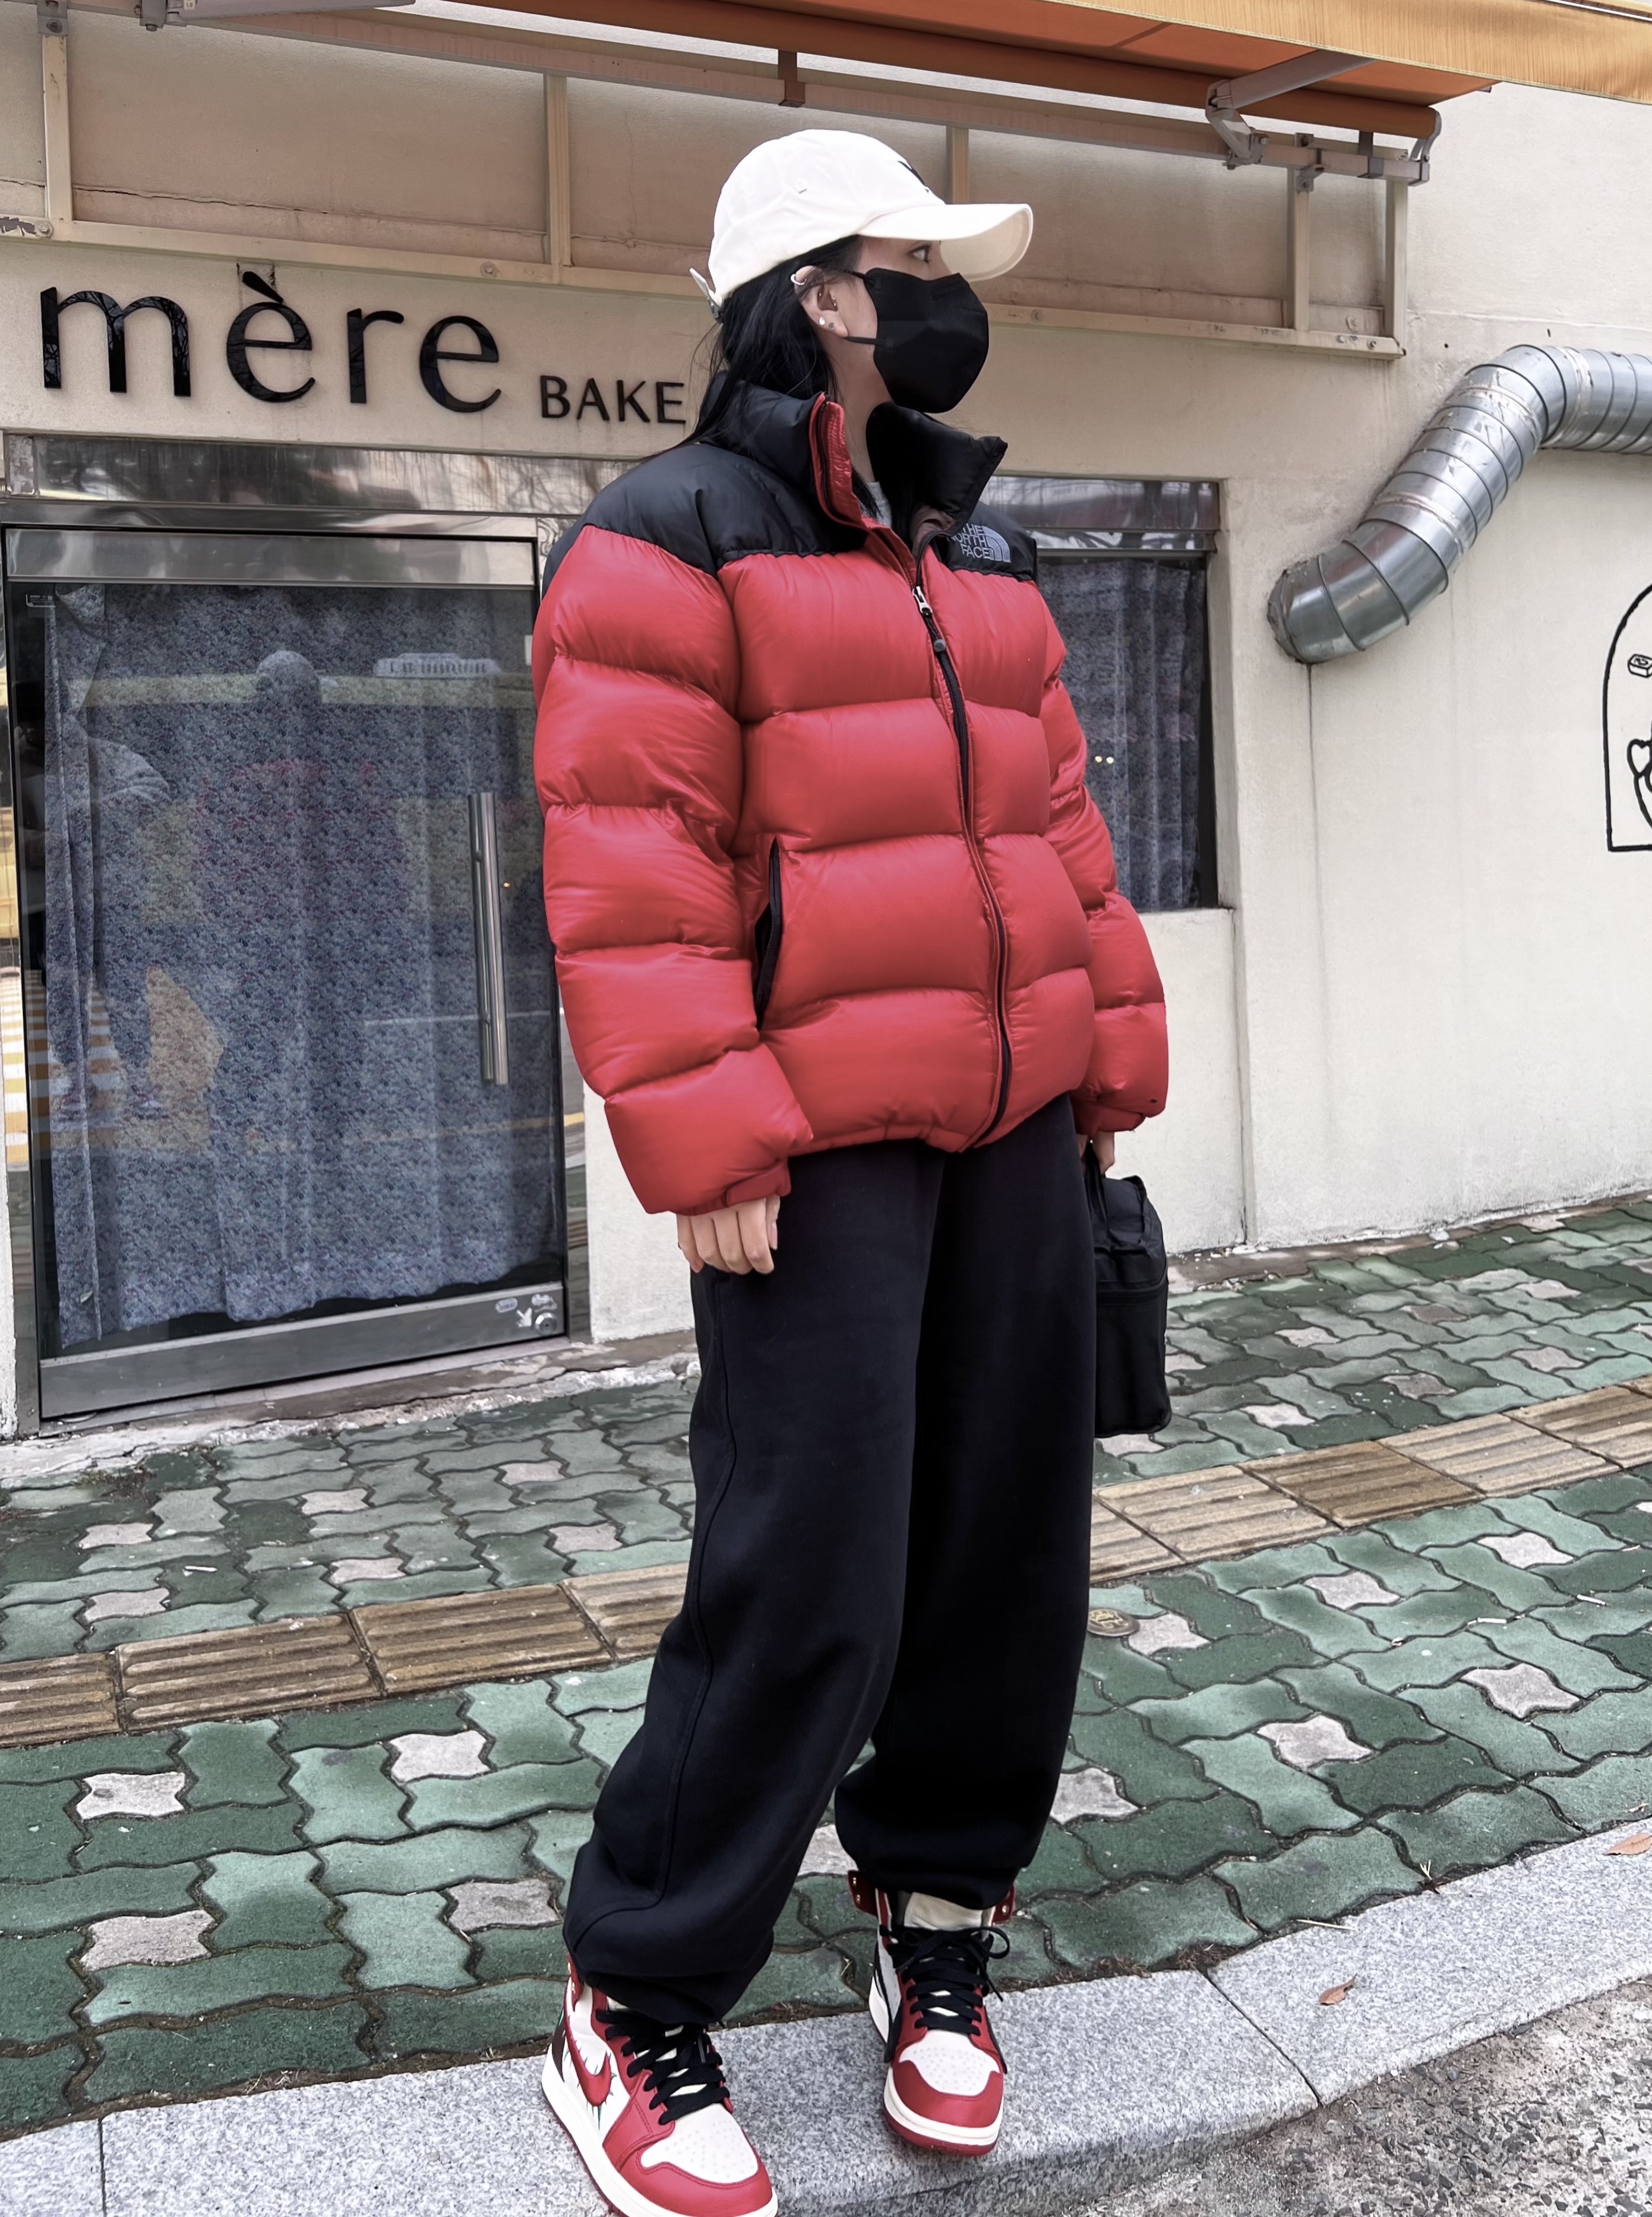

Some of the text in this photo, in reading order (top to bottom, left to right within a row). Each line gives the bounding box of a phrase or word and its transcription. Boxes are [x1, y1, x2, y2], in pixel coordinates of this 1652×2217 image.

[40, 271, 687, 424] mère BAKE
[960, 543, 991, 559] FACE
